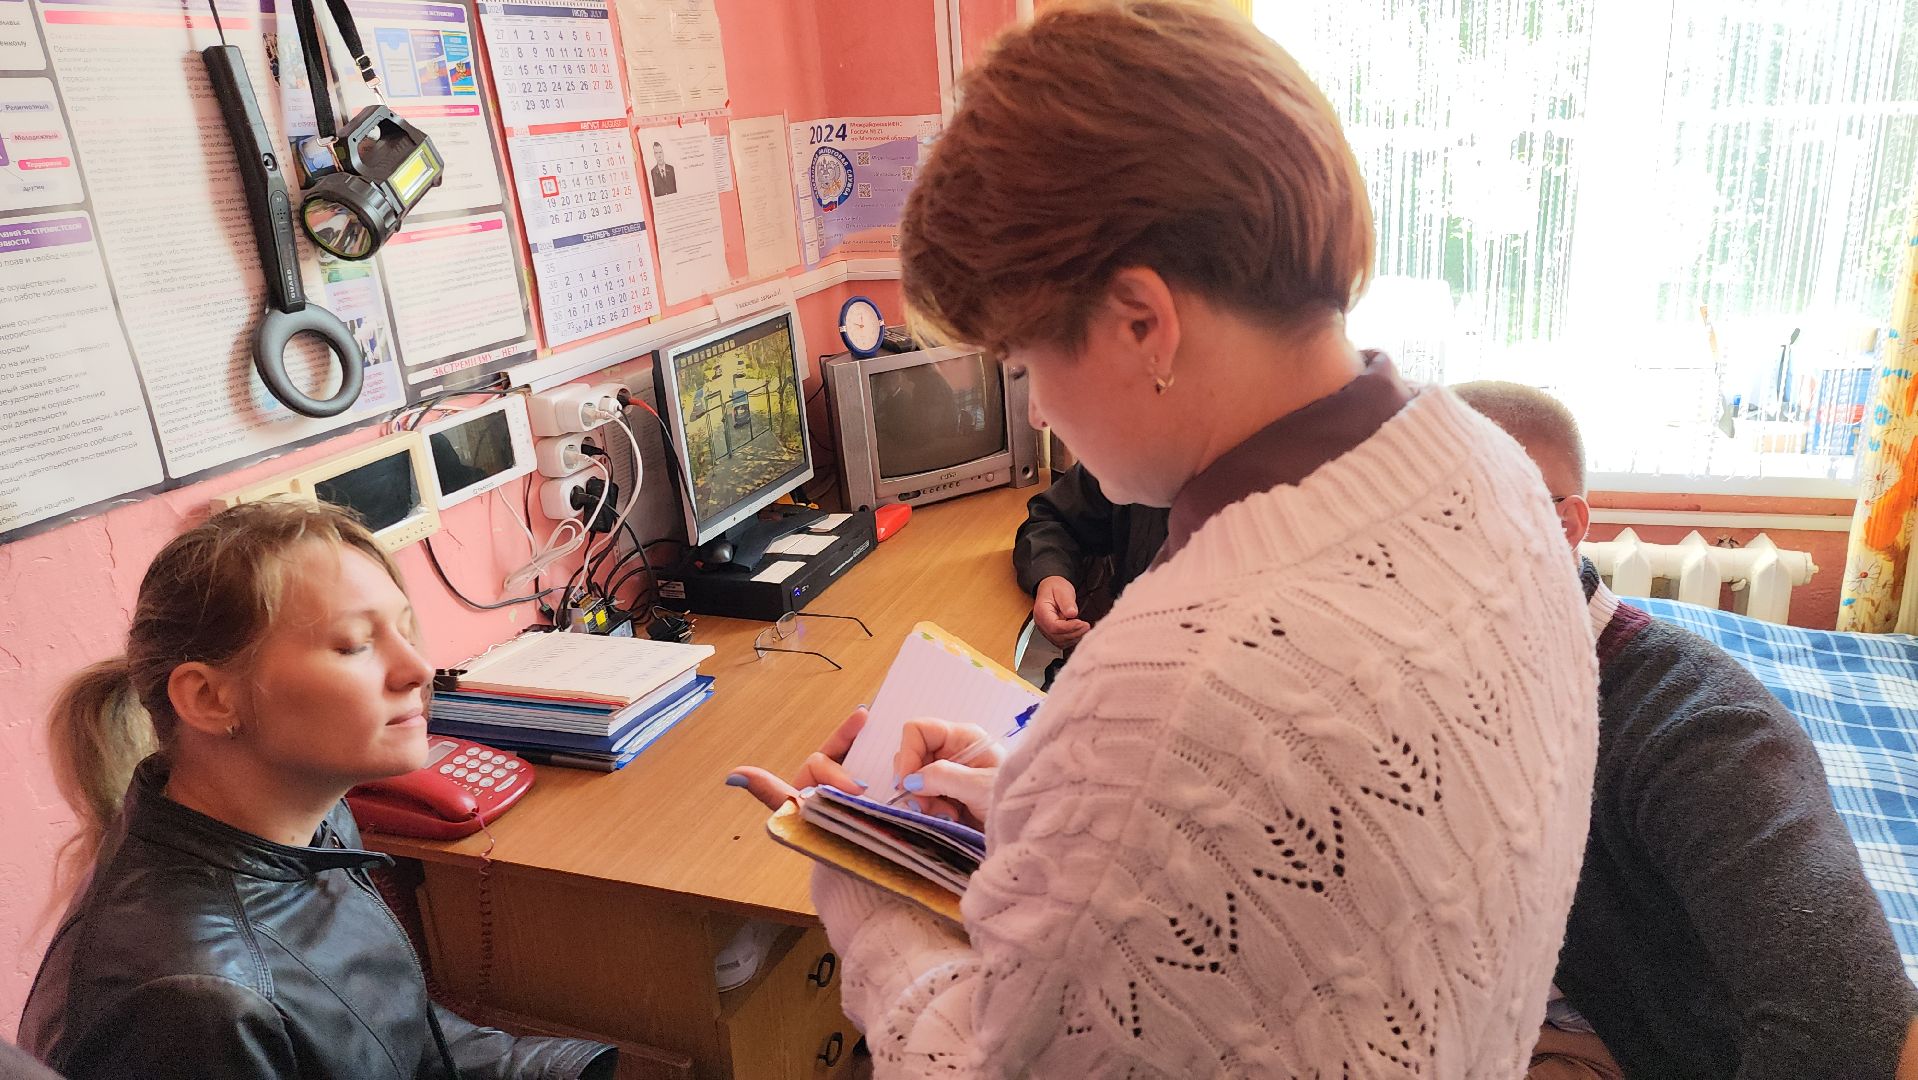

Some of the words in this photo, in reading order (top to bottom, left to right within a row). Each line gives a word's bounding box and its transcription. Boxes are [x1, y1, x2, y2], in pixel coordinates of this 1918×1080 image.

[514, 29, 518, 39] 1
[529, 30, 534, 40] 2
[544, 31, 549, 40] 3
[559, 31, 563, 40] 4
[573, 31, 577, 40] 5
[586, 32, 590, 40] 6
[598, 32, 602, 41] 7
[518, 48, 523, 57] 8
[533, 48, 538, 57] 9
[546, 48, 554, 57] 10
[560, 48, 568, 57] 11
[574, 48, 583, 57] 12
[587, 48, 595, 57] 13
[600, 48, 607, 57] 14
[519, 65, 528, 75] 15
[534, 65, 544, 75] 16
[549, 65, 557, 75] 17
[563, 65, 572, 74] 18
[577, 65, 585, 74] 19
[590, 64, 597, 73] 20
[602, 64, 610, 73] 21
[522, 83, 532, 93] 22
[537, 82, 547, 92] 23
[552, 82, 561, 91] 24
[566, 82, 575, 91] 25
[580, 81, 588, 90] 26
[593, 81, 599, 90] 27
[526, 100, 535, 110] 29
[540, 99, 550, 109] 30
[555, 98, 564, 108] 31
[810, 124, 847, 144] 2024
[581, 144, 584, 152] 1
[594, 143, 598, 152] 2
[543, 165, 547, 175] 5
[557, 164, 561, 173] 6
[584, 160, 588, 169] 8
[596, 159, 600, 167] 9
[544, 182, 552, 191] 12
[559, 180, 567, 189] 13
[572, 178, 580, 187] 14
[585, 176, 593, 185] 15
[598, 175, 606, 183] 16
[548, 199, 556, 208] 19
[561, 197, 570, 206] 20
[574, 194, 583, 203] 21
[588, 192, 596, 201] 22
[600, 190, 608, 199] 23
[624, 186, 631, 196] 25
[550, 215, 559, 224] 26
[564, 212, 572, 222] 27
[615, 203, 622, 212] 31
[637, 244, 640, 252] 1
[287, 269, 296, 299] GUARD
[565, 276, 570, 285] 2
[579, 273, 583, 282] 3
[592, 270, 596, 279] 4
[605, 267, 608, 275] 5
[568, 293, 572, 301] 9
[580, 288, 587, 298] 10
[593, 285, 599, 294] 11
[605, 282, 612, 291] 12
[617, 279, 624, 288] 13
[629, 275, 635, 284] 14
[640, 273, 647, 281] 15
[568, 307, 577, 317] 16
[582, 304, 590, 313] 17
[595, 300, 603, 310] 18
[608, 297, 615, 306] 19
[619, 293, 627, 302] 20
[631, 291, 638, 299] 21
[643, 287, 650, 296] 22
[584, 319, 593, 329] 24
[597, 316, 606, 325] 25
[610, 311, 618, 321] 26
[622, 308, 629, 317] 27
